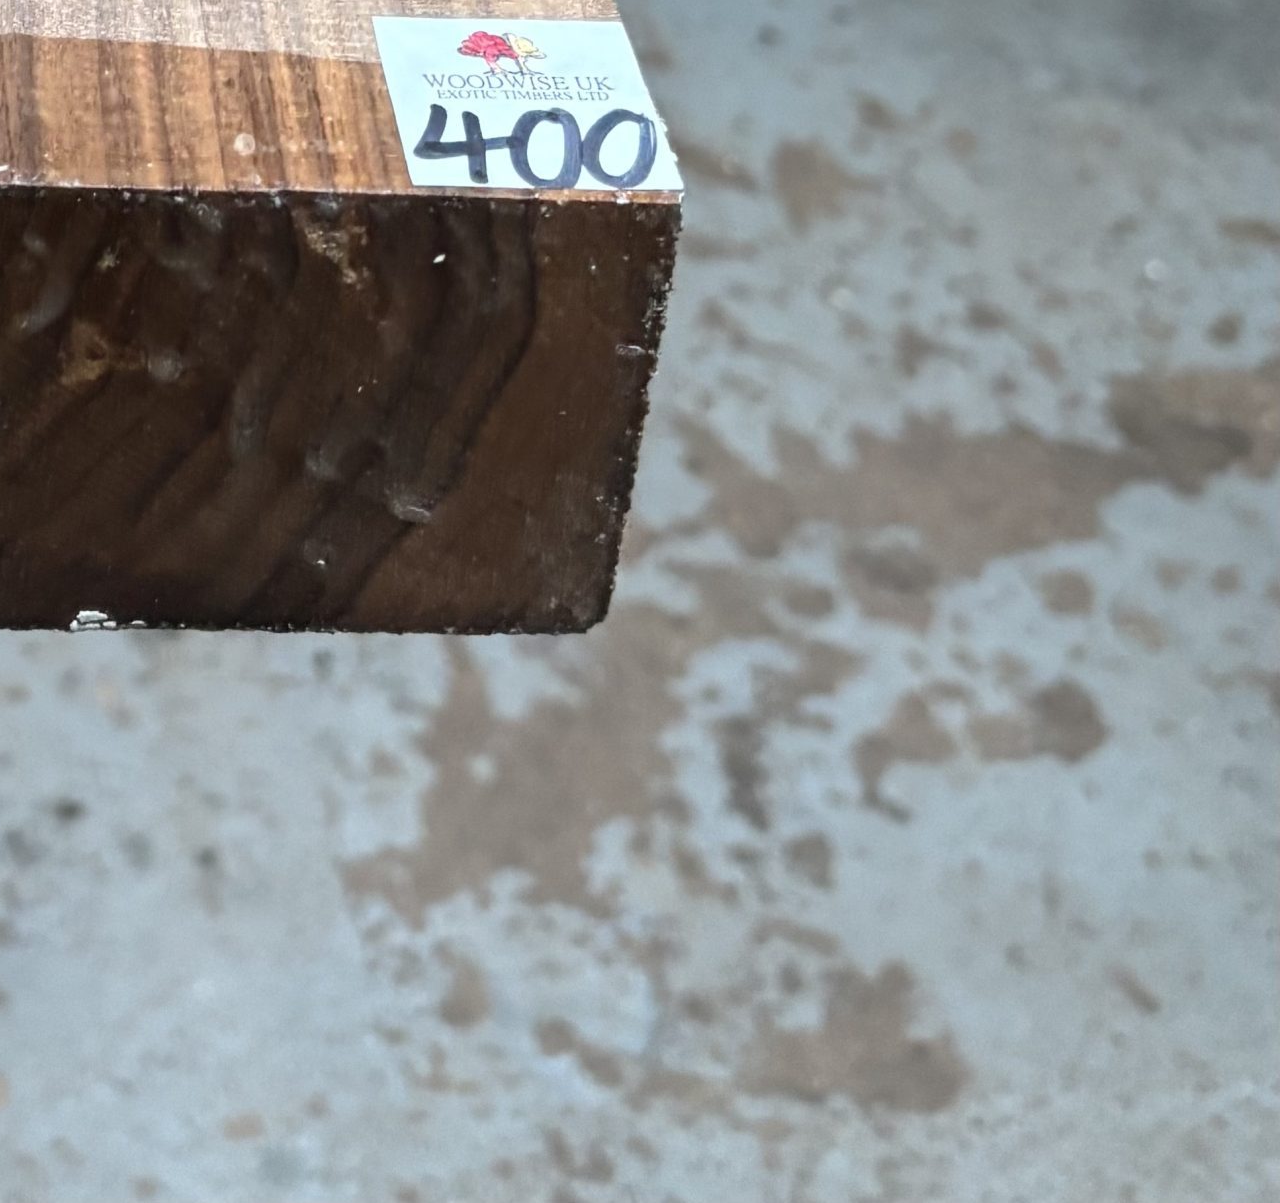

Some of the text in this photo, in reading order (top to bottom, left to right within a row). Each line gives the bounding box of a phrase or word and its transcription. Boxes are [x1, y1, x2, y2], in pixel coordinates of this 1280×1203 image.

[422, 73, 616, 91] WOODWISE UK
[437, 89, 610, 102] EXOTIC TIMBERS LTD
[413, 103, 658, 189] 400
